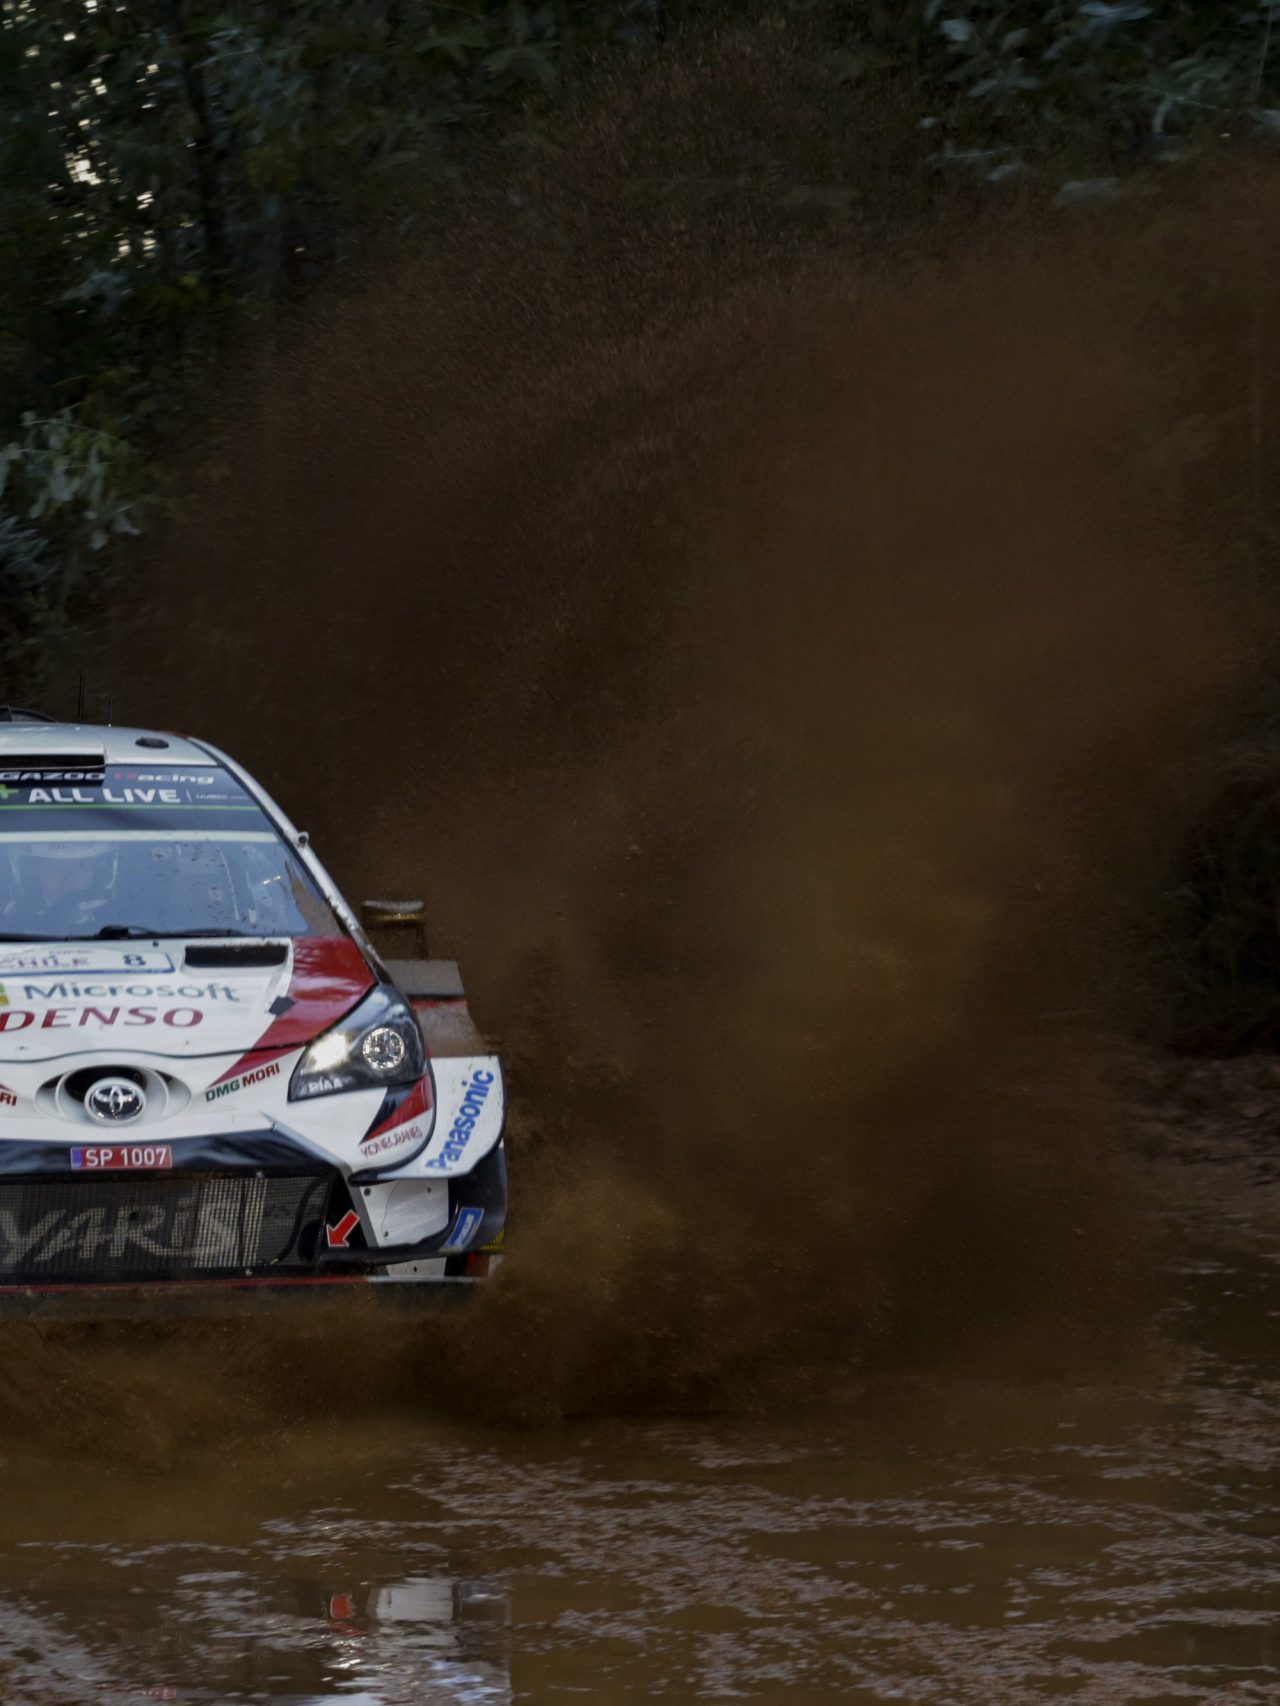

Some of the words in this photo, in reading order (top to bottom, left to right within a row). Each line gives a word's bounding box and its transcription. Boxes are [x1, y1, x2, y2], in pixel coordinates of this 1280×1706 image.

[28, 788, 94, 803] ALL
[102, 788, 180, 803] LIVE
[123, 954, 147, 967] 8
[23, 982, 238, 1001] Microsoft
[205, 1081, 241, 1102] DMG
[241, 1062, 280, 1087] MORI
[308, 1077, 344, 1093] PIAA
[424, 1070, 495, 1170] Panasonic
[85, 1149, 113, 1167] SP
[120, 1148, 167, 1166] 1007
